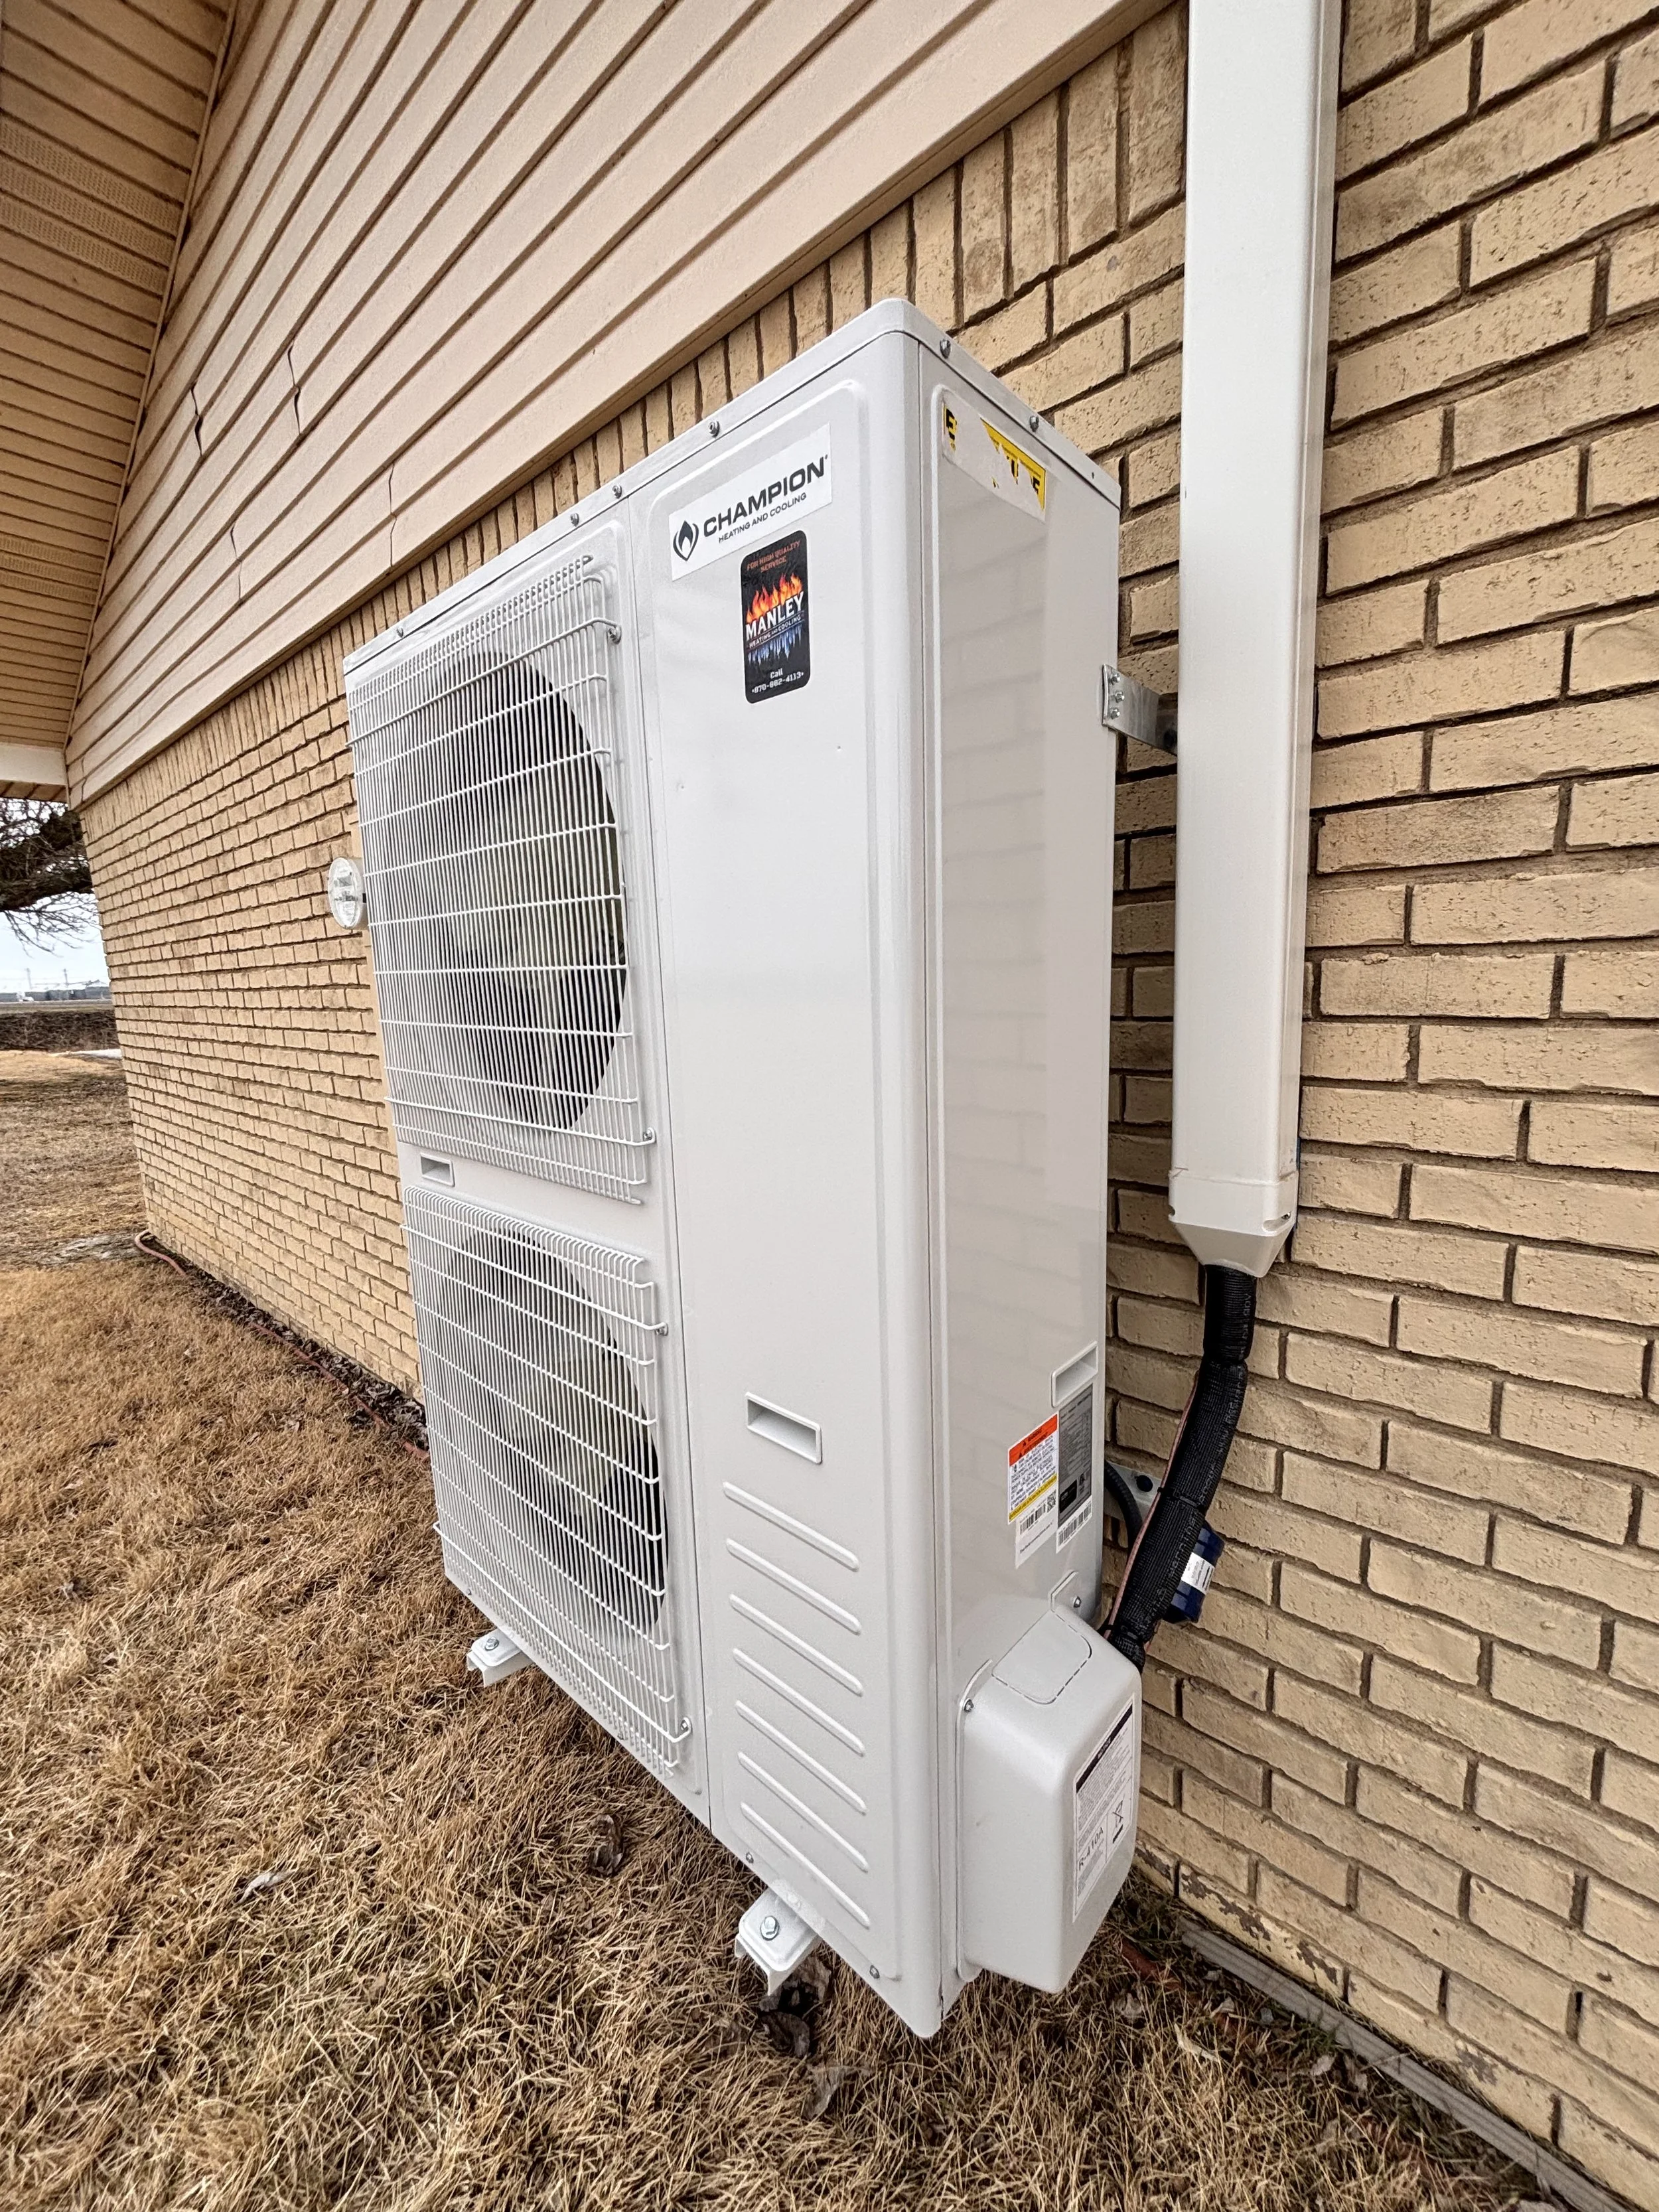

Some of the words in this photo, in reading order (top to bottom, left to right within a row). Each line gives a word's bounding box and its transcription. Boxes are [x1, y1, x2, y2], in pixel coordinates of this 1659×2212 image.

[703, 456, 825, 538] CHAMPION
[719, 522, 751, 544] HEATING
[752, 512, 768, 526] AND
[769, 492, 807, 516] COOLING
[747, 561, 758, 571] FOR
[759, 552, 774, 565] HIGH
[774, 540, 800, 558] QUALITY
[760, 555, 786, 573] SERVICE
[745, 591, 804, 642] MANLEY
[749, 633, 771, 648] HEATING
[778, 615, 801, 632] COOLING
[770, 668, 783, 680] Call
[1078, 1826, 1104, 1871] R-410A
